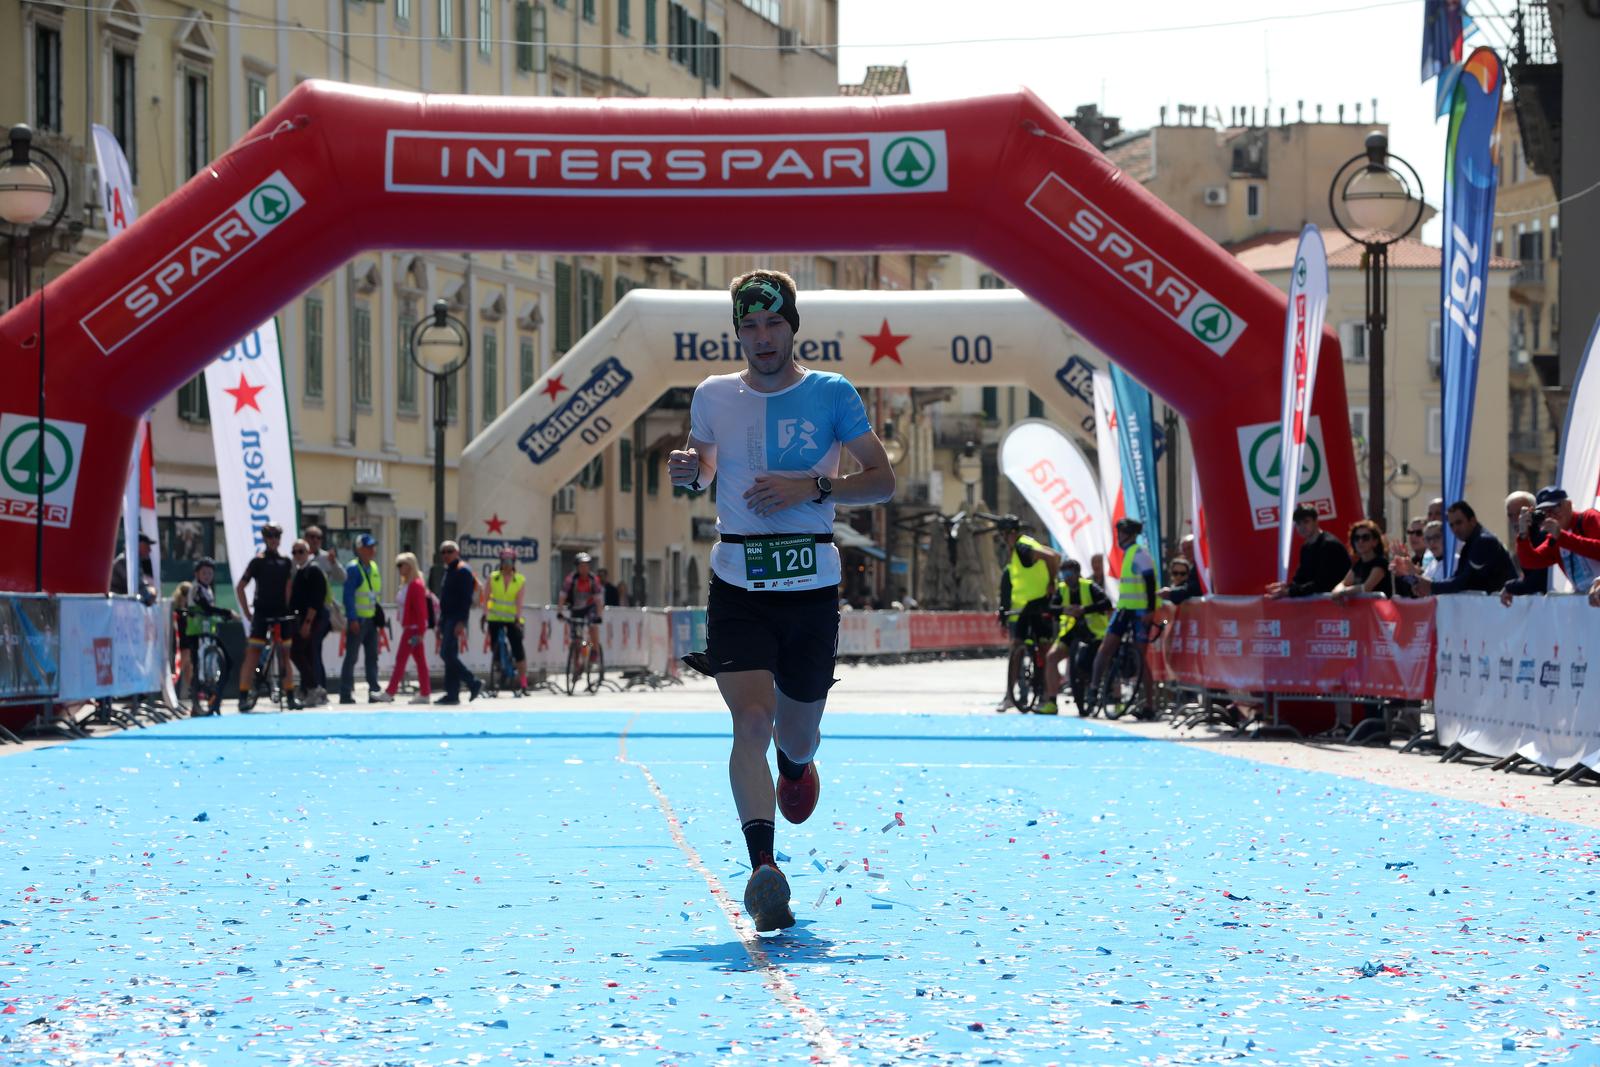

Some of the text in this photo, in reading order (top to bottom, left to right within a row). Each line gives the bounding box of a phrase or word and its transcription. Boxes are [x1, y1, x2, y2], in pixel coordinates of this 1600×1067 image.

[441, 146, 865, 181] INTERSPAR
[124, 217, 251, 319] SPAR
[1068, 208, 1192, 311] SPAR
[951, 334, 993, 365] 0.0
[525, 367, 626, 457] Heineken
[746, 547, 763, 555] RUN
[772, 547, 814, 572] 120
